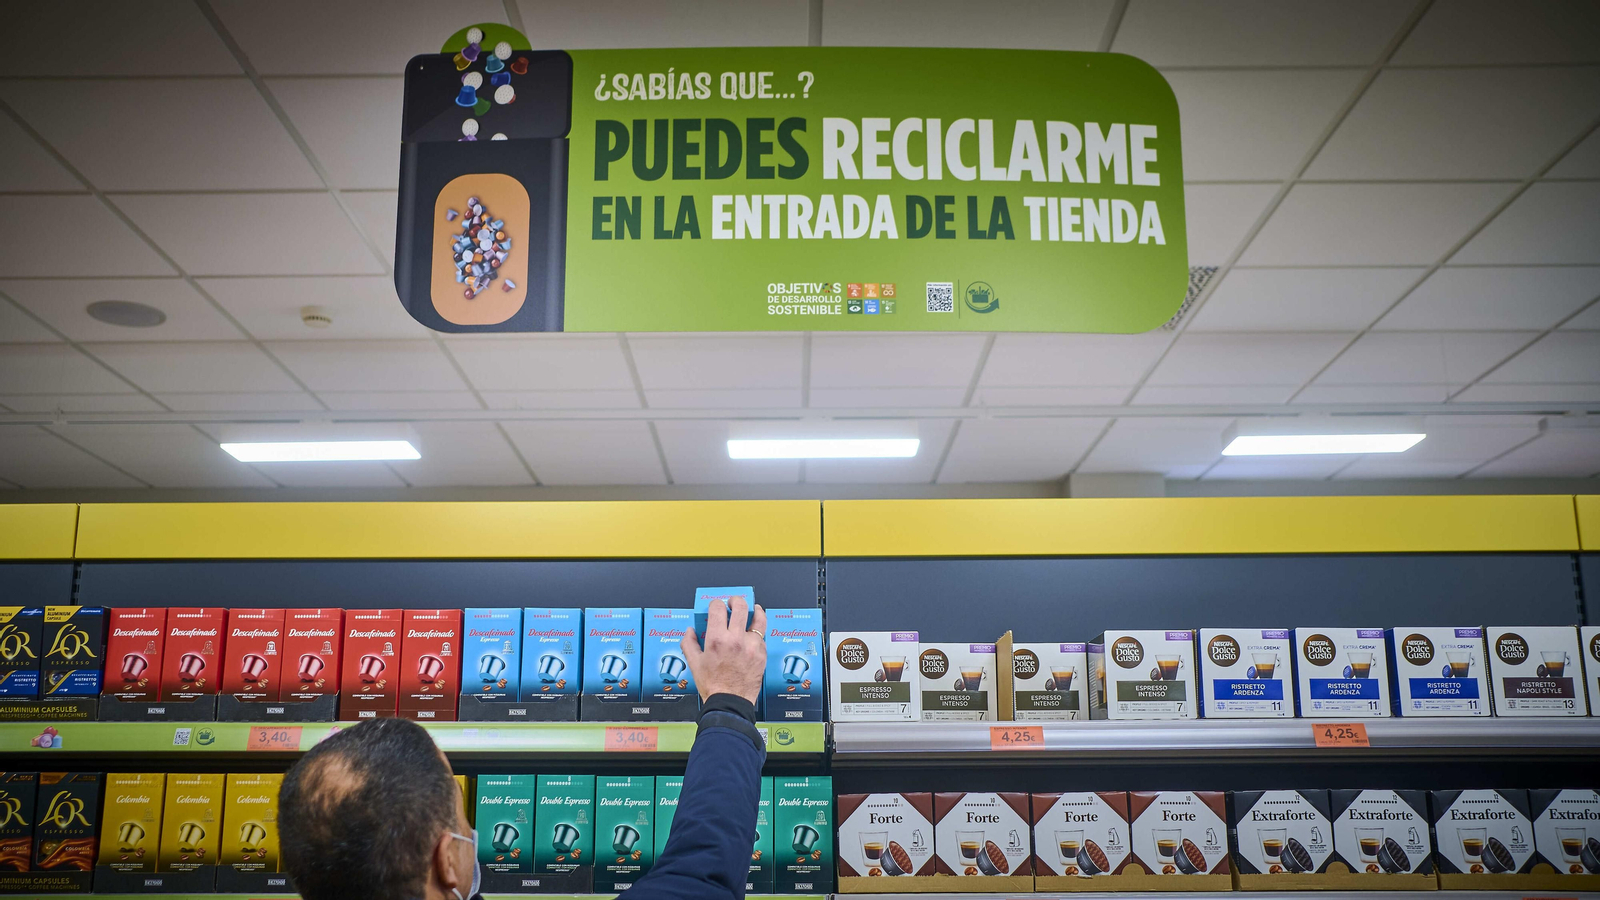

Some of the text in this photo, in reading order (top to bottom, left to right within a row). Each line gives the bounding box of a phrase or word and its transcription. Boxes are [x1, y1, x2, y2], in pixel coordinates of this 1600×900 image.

[594, 67, 815, 101] ¿SABÍAS QUE...?
[594, 116, 1161, 187] PUEDES RECICLARME
[591, 194, 1167, 245] EN LA ENTRADA DE LA TIENDA
[767, 282, 842, 294] OBJETIVOS
[767, 295, 842, 304] DE DESARROLLO
[767, 304, 842, 315] SOSTENIBLE
[113, 628, 160, 639] Descafeinado
[170, 628, 217, 639] Descafeinado
[231, 628, 279, 639] Descafeinado
[288, 628, 335, 639] Descafeinado
[349, 629, 396, 640] Descafeinado
[407, 629, 454, 640] Descafeinado
[469, 629, 515, 639] Descafeinado
[528, 629, 575, 639] Descafeinado
[589, 629, 637, 639] Descafeinado
[648, 629, 687, 638] Descafeina
[770, 629, 818, 638] Descafeinado
[840, 649, 865, 658] Dolce
[1115, 648, 1140, 657] Dolce
[1212, 646, 1236, 655] Dolce
[1307, 645, 1331, 654] Dolce
[1406, 645, 1430, 654] Dolce
[1499, 644, 1524, 653] Dolce
[841, 656, 865, 665] Gusto
[1115, 655, 1140, 664] Gusto
[1212, 653, 1237, 661] Gusto
[1307, 652, 1332, 661] Gusto
[1406, 652, 1431, 661] Gusto
[1500, 651, 1525, 660] Gusto
[922, 659, 945, 668] Dolce
[1014, 659, 1036, 668] Dolce
[922, 666, 945, 674] Gusto
[1013, 665, 1036, 674] Gusto
[1516, 687, 1541, 695] NAPOLI
[900, 703, 907, 713] 7
[1176, 702, 1183, 712] 7
[1271, 701, 1281, 711] 11
[1367, 700, 1377, 710] 11
[1467, 700, 1477, 709] 11
[1562, 699, 1574, 709] 13
[978, 712, 985, 721] 7
[1070, 711, 1076, 720] 7
[259, 731, 292, 744] 3,40€
[616, 731, 649, 744] 3,40€
[1001, 731, 1036, 743] 4,25€
[1325, 728, 1359, 740] 4,25€
[116, 795, 150, 804] Colombia
[176, 795, 210, 804] Colombia
[236, 795, 270, 804] Colombia
[480, 796, 531, 807] Double Espresso
[540, 796, 591, 807] Double Espresso
[600, 797, 651, 808] Double Espresso
[659, 797, 679, 806] Doub
[778, 797, 801, 807] Double
[802, 798, 829, 808] Espresso
[869, 812, 903, 825] Forte
[966, 811, 1000, 824] Forte
[1064, 811, 1099, 823] Forte
[1162, 810, 1197, 822] Forte
[1251, 809, 1316, 822] Extraforte
[1348, 808, 1414, 821] Extraforte
[1450, 808, 1516, 821] Extraforte
[1549, 808, 1600, 821] Extrafor
